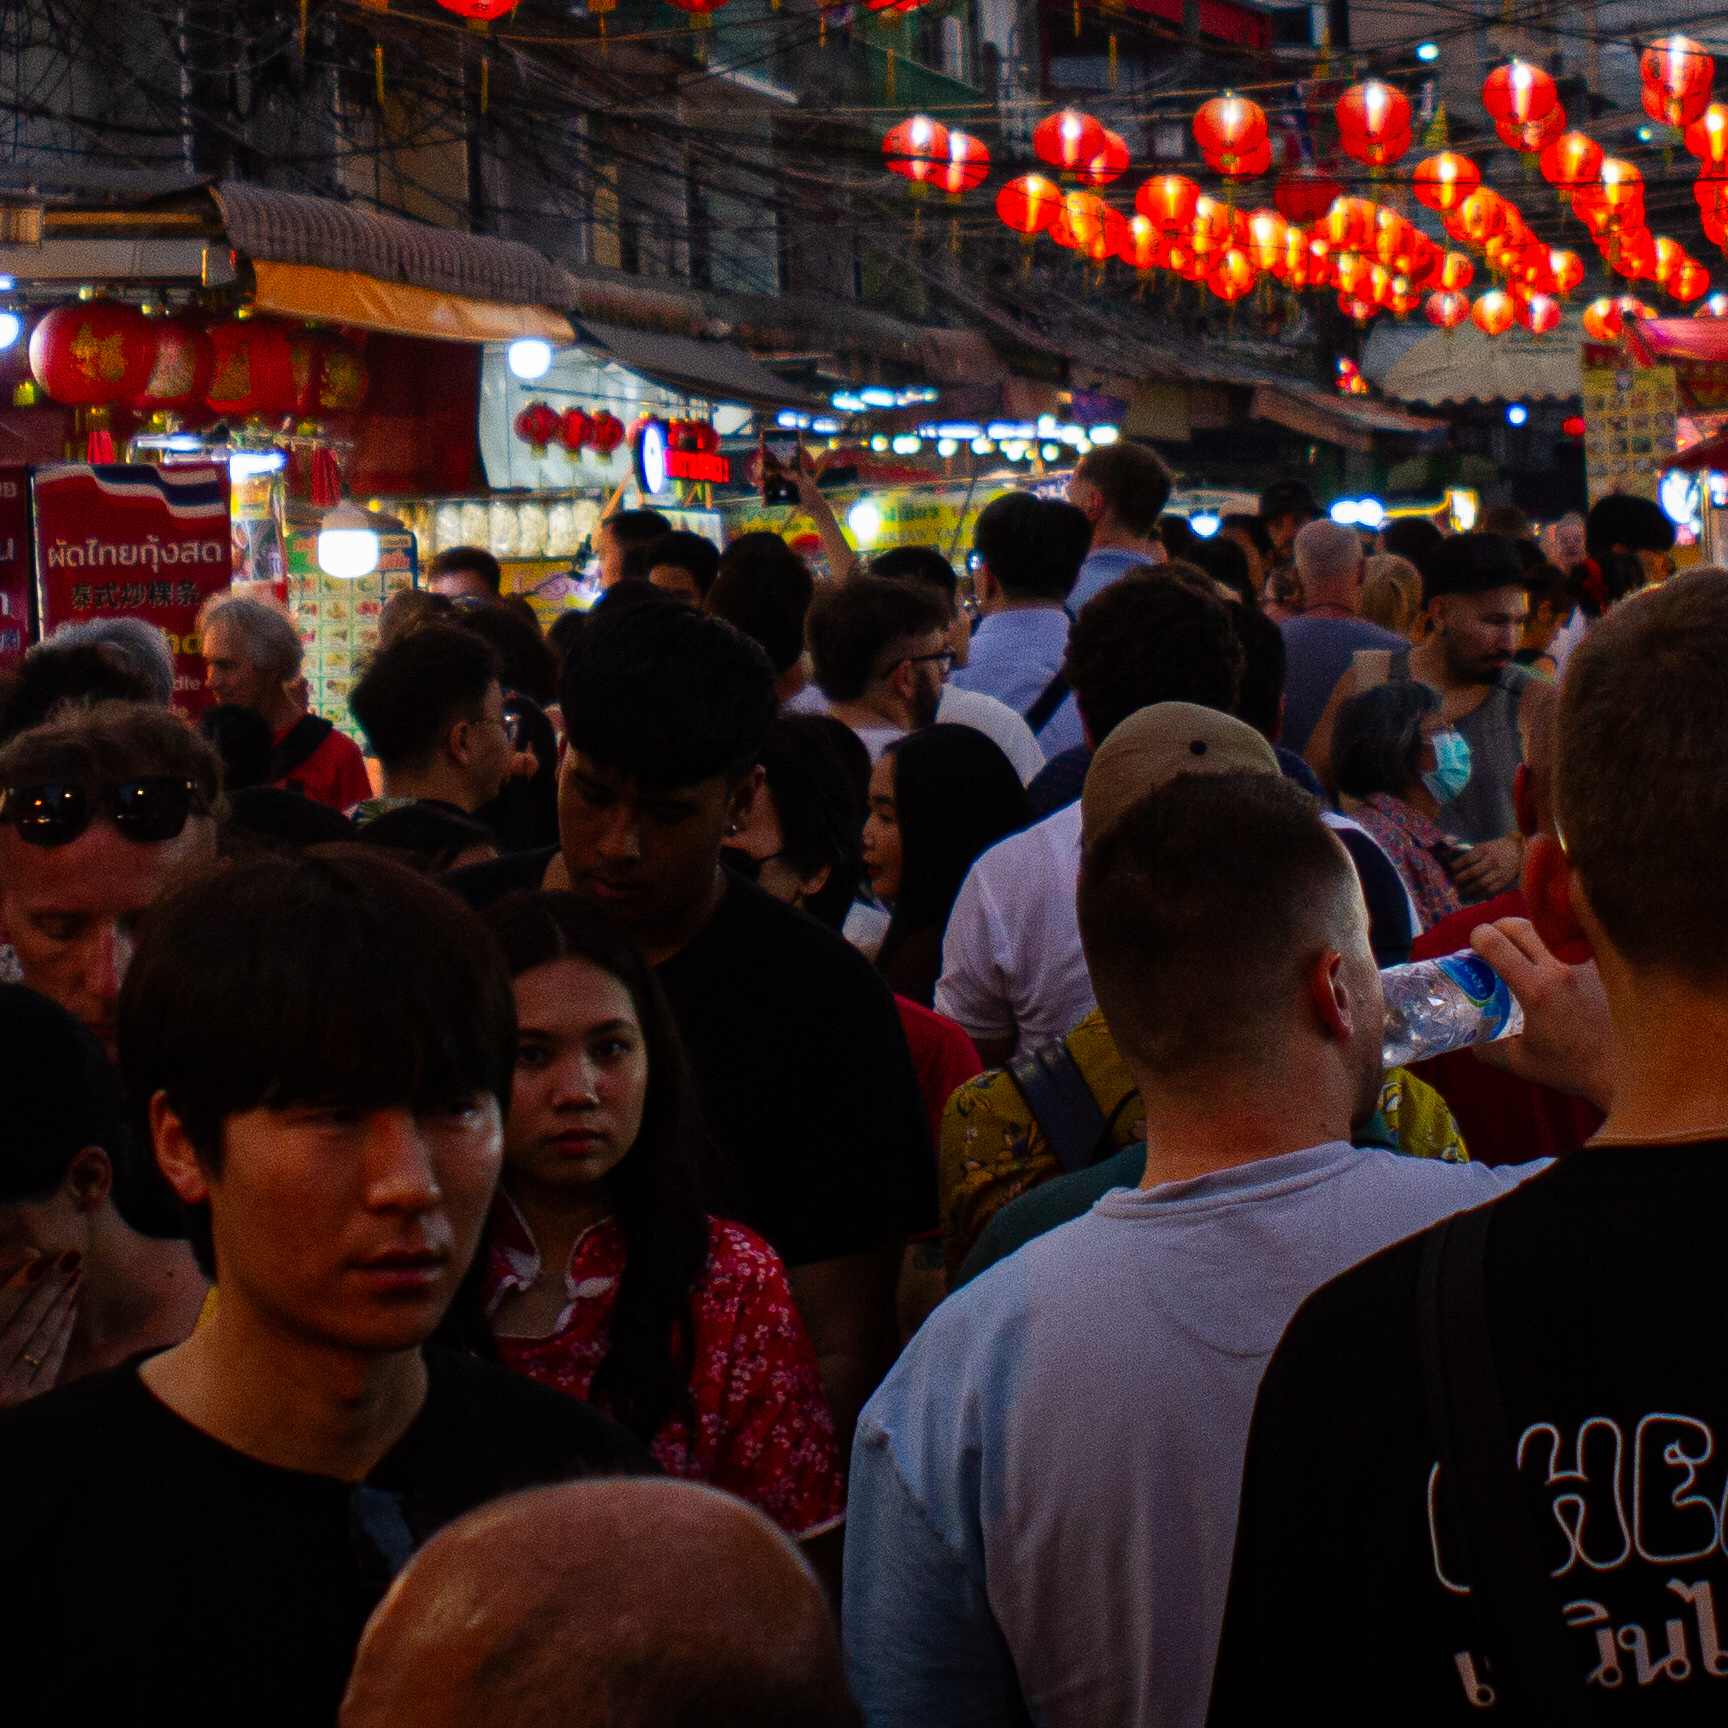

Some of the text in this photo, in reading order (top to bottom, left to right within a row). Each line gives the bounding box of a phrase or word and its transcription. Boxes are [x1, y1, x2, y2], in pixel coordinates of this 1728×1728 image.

[47, 534, 223, 574] ผัดไทยกุ้งสด
